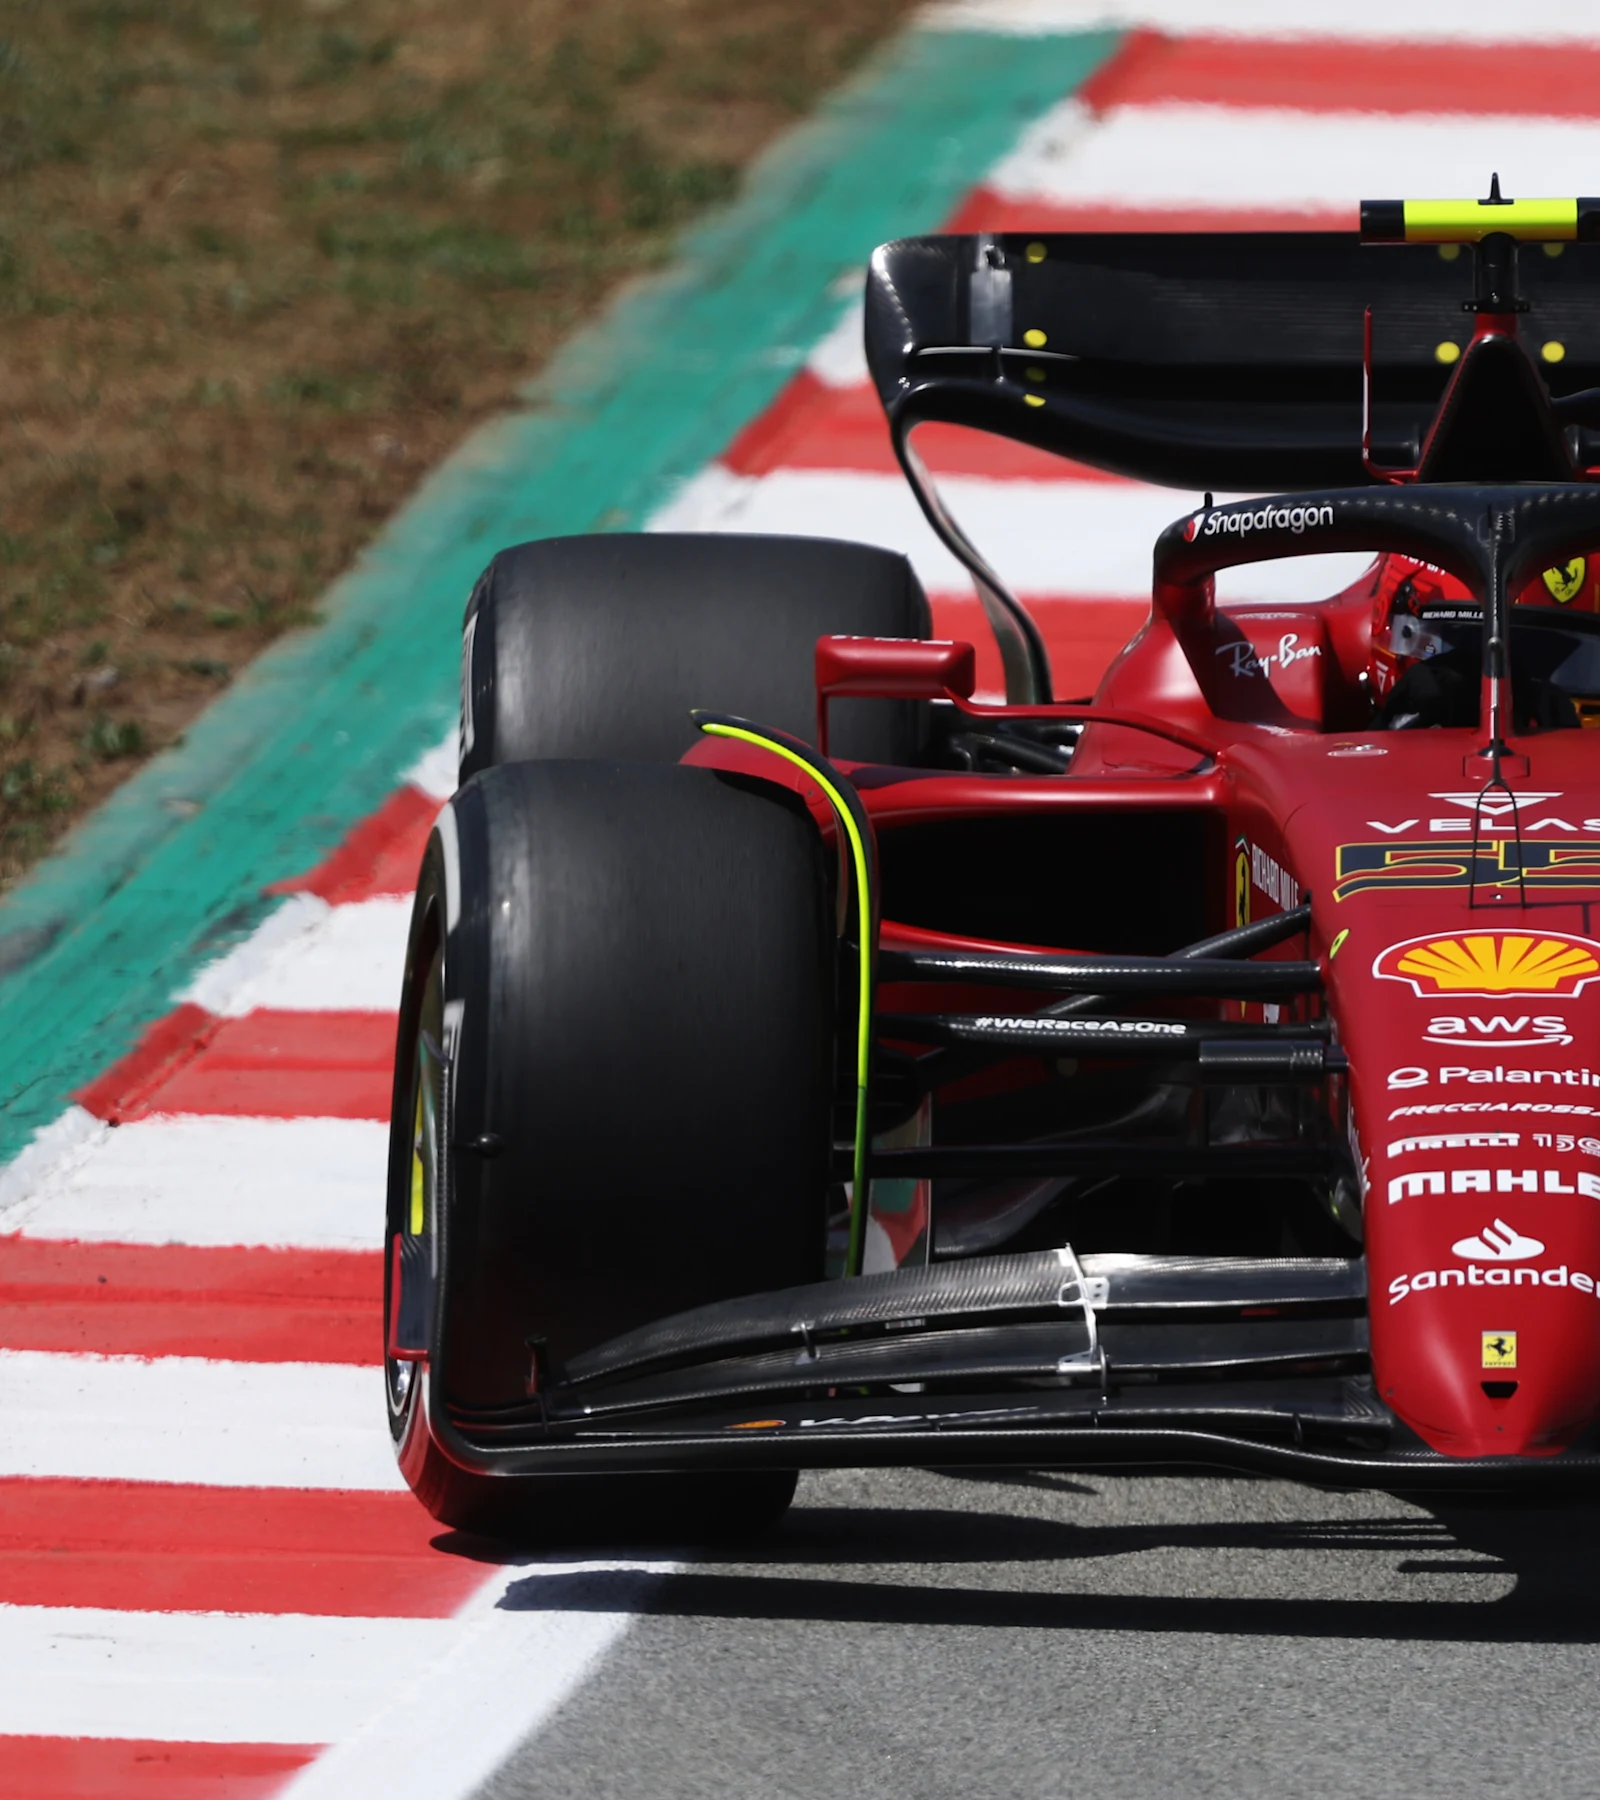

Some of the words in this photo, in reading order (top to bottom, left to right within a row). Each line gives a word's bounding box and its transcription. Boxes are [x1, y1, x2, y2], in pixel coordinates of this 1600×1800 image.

[1204, 504, 1334, 538] Snapdragon
[974, 1017, 1188, 1035] #WeRaceAsOne
[1427, 1015, 1568, 1035] aws
[1387, 1132, 1521, 1159] PIRELLI
